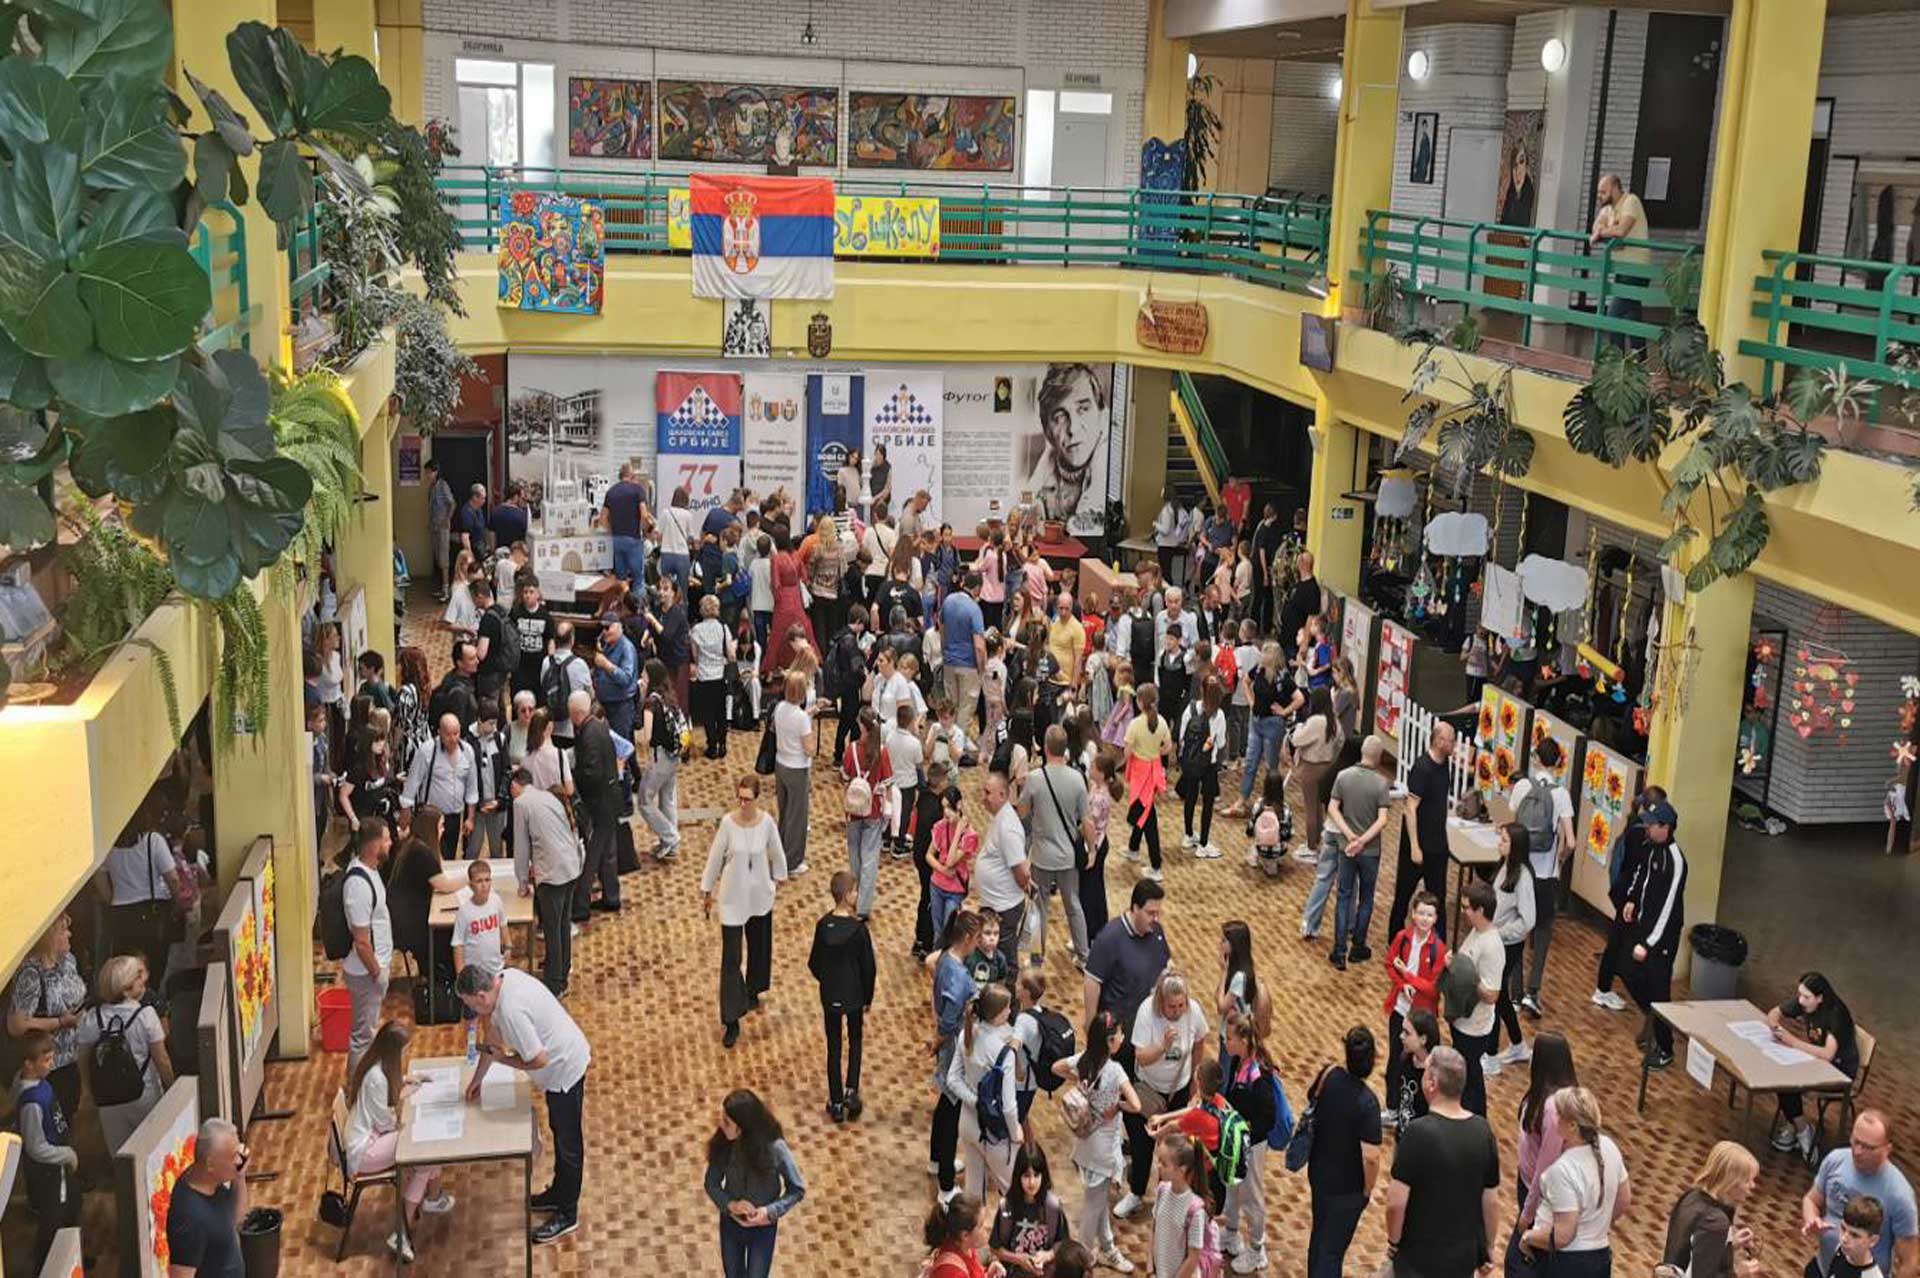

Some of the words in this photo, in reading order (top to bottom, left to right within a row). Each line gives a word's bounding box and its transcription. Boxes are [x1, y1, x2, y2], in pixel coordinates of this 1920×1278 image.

[668, 437, 729, 448] СРБИЈЕ
[872, 434, 936, 446] СРБИЈЕ
[679, 464, 718, 496] 77
